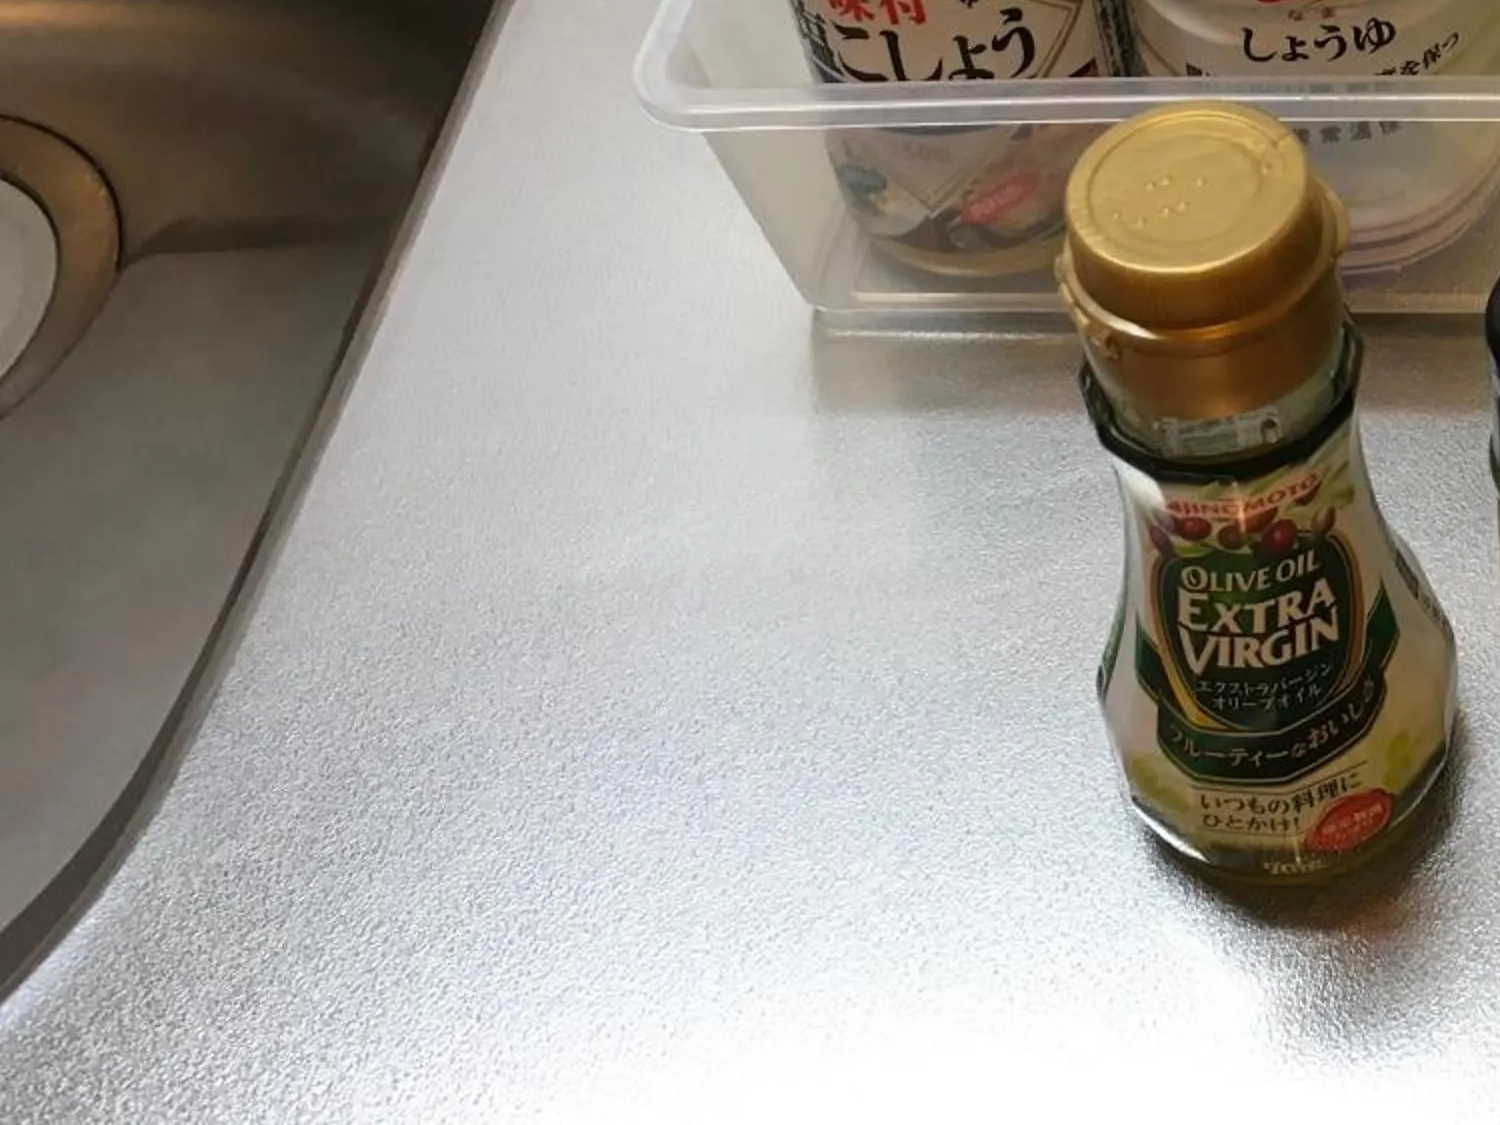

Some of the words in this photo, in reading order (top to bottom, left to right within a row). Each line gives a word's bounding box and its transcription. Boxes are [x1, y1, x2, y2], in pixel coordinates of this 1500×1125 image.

[1241, 16, 1397, 63] しょうゆ
[1180, 565, 1274, 594] OLIVE
[1275, 549, 1323, 583] OIL
[1176, 577, 1338, 635] EXTRA
[1178, 606, 1341, 676] VIRGIN
[1212, 683, 1323, 711] オリーブオイル
[1200, 774, 1362, 815] いつもの料理に
